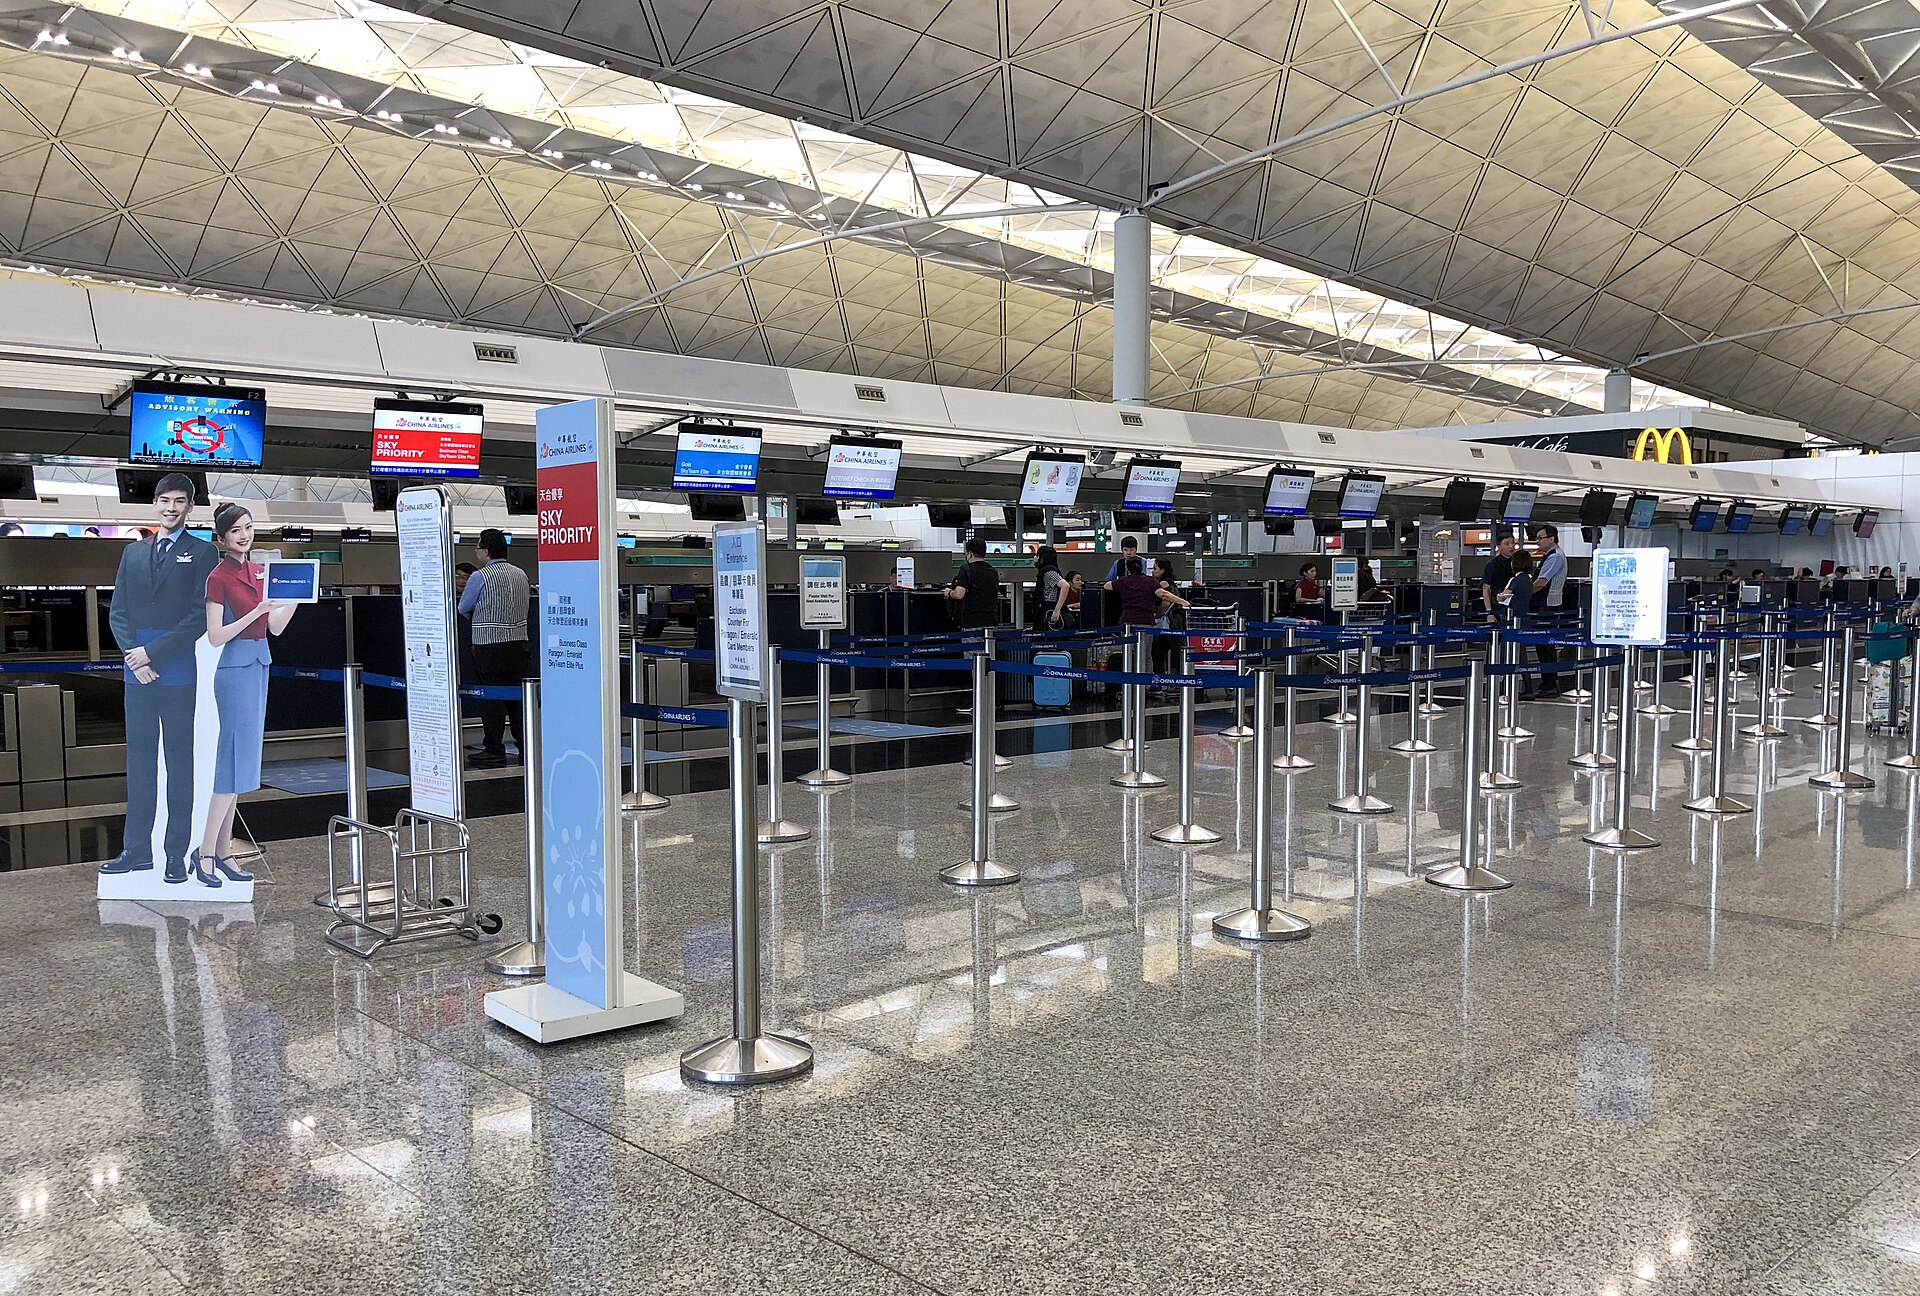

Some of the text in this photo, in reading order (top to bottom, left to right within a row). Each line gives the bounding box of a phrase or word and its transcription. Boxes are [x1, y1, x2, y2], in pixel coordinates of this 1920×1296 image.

[148, 403, 251, 416] ADVISORY WARNING
[376, 449, 424, 458] PRIORITY
[549, 444, 587, 457] CHINA AIRLINES
[540, 488, 563, 502] 天合優享
[416, 502, 434, 511] AIRLINES
[540, 509, 563, 526] SKY
[540, 526, 593, 545] PRIORITY
[732, 537, 741, 548] 入口
[727, 554, 747, 564] Entrance
[729, 606, 747, 615] Exclusive
[728, 618, 742, 626] Counter
[721, 629, 737, 640] Paragon
[741, 631, 758, 640] Emerald
[559, 639, 587, 648] Business Class
[727, 642, 754, 652] Card Members
[548, 649, 564, 658] Paragon
[567, 650, 582, 658] Emerald
[549, 659, 565, 668] SkyTeam
